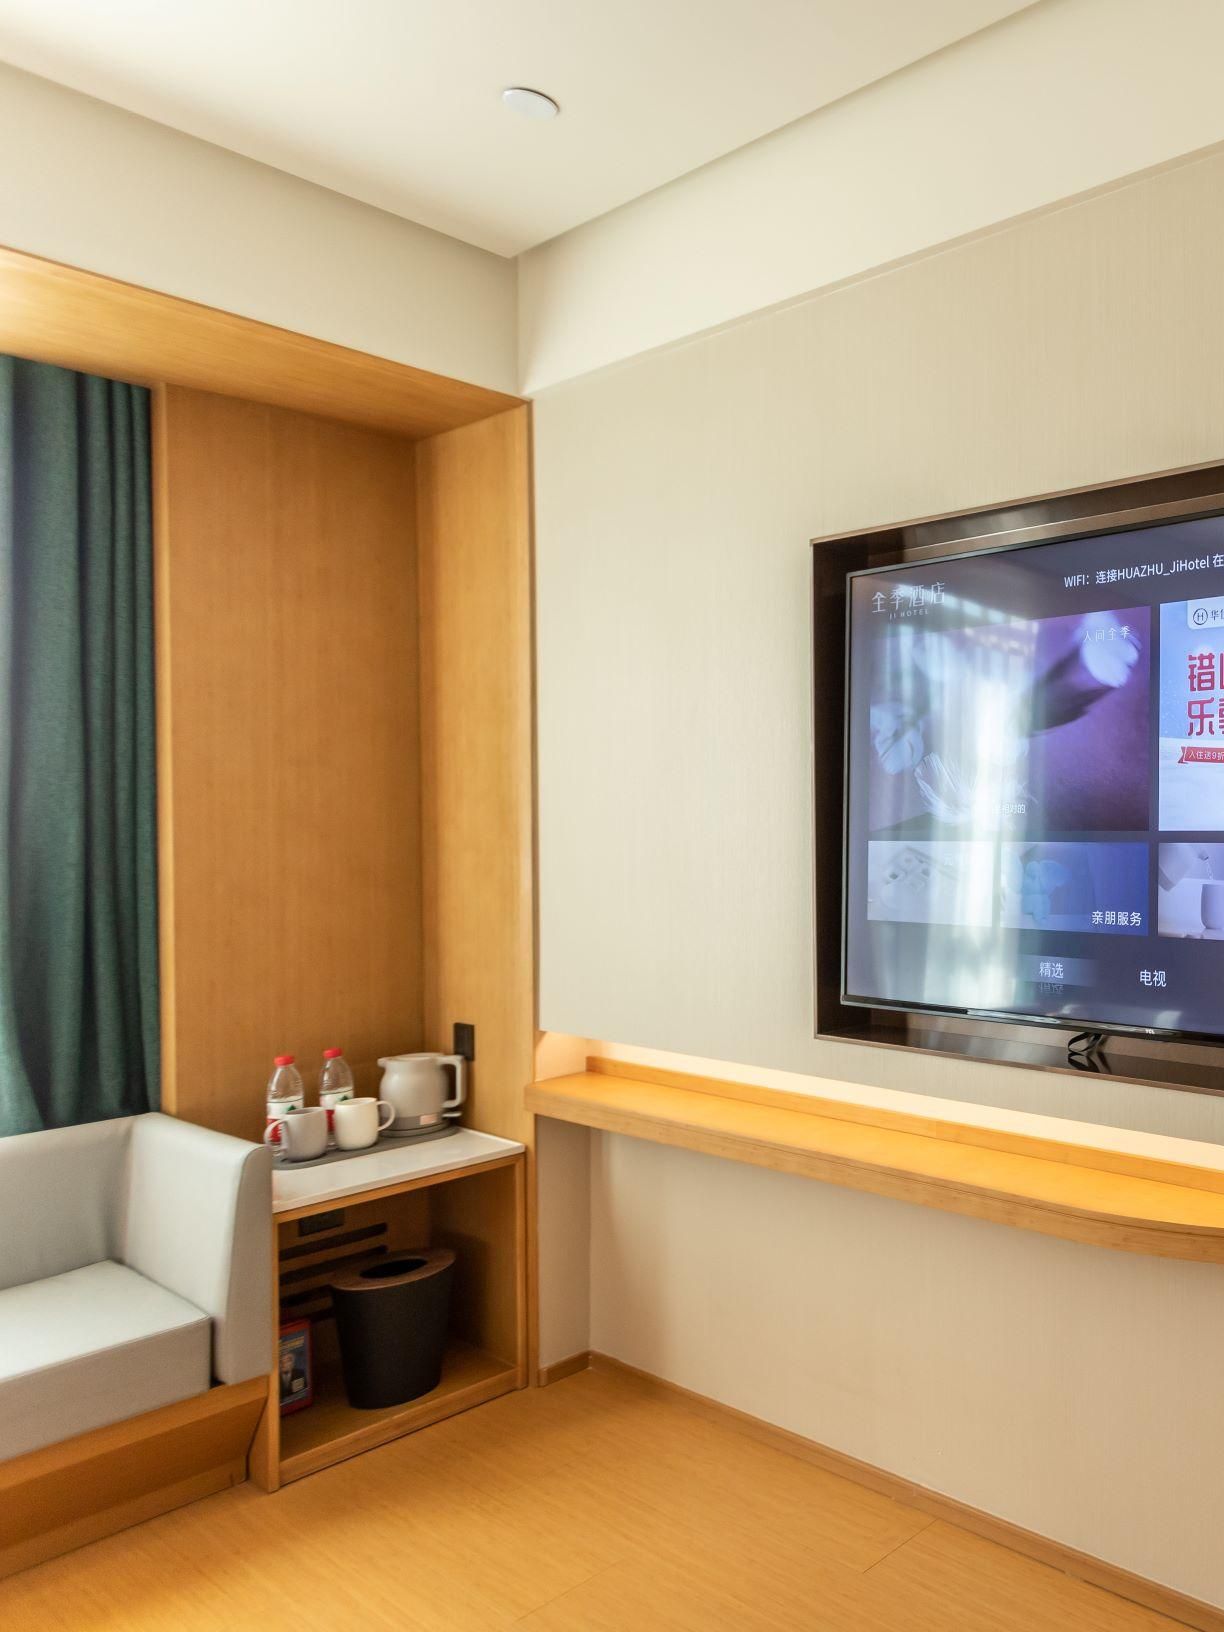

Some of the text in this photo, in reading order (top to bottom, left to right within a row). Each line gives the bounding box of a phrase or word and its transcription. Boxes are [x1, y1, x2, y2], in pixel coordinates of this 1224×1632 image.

[871, 581, 945, 613] 全季酒店
[900, 608, 929, 617] HOTEL
[1091, 910, 1142, 927] 亲朋服务
[1039, 961, 1064, 979] 精选
[1139, 969, 1167, 988] 电视
